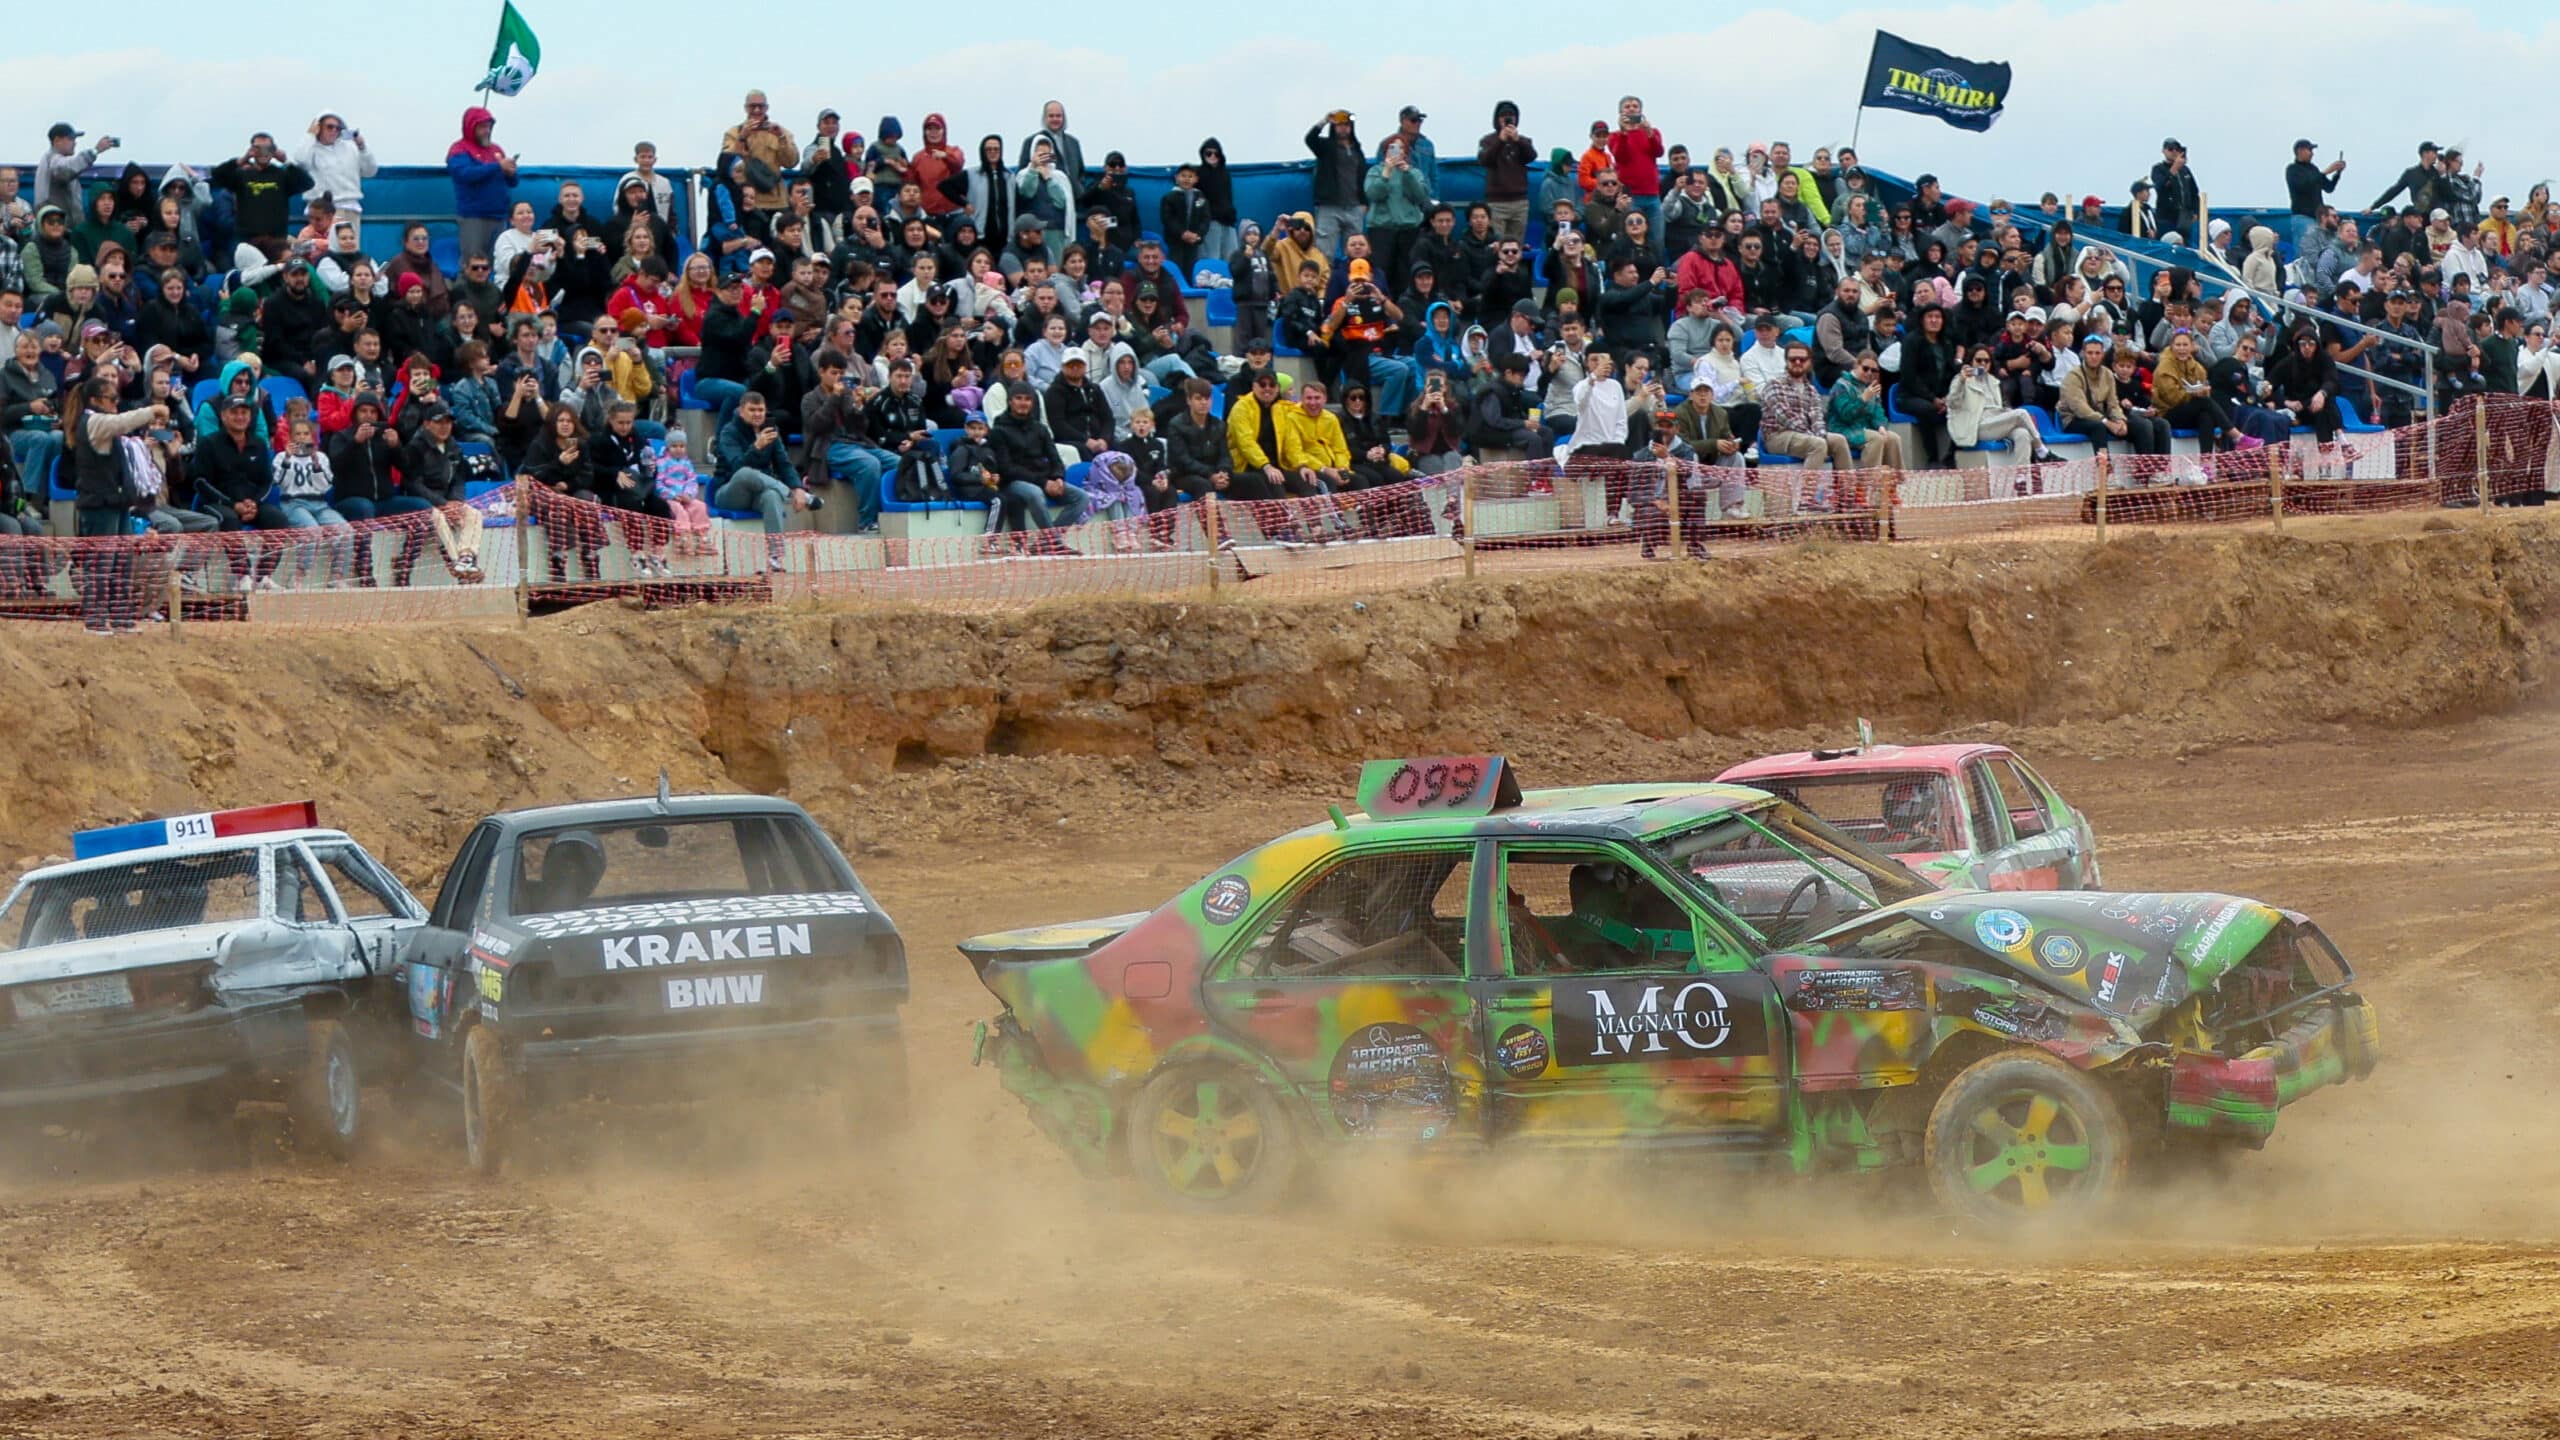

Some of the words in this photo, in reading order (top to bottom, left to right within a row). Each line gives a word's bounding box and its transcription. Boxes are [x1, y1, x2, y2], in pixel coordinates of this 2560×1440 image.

[1888, 68, 1931, 95] TRI
[1936, 82, 1995, 107] MIRA
[1389, 763, 1479, 807] 099
[175, 818, 208, 838] 911
[602, 923, 812, 970] KRAKEN
[667, 974, 764, 1009] BMW
[1596, 1012, 1688, 1035] MAGNAT
[1695, 1009, 1732, 1029] OIL
